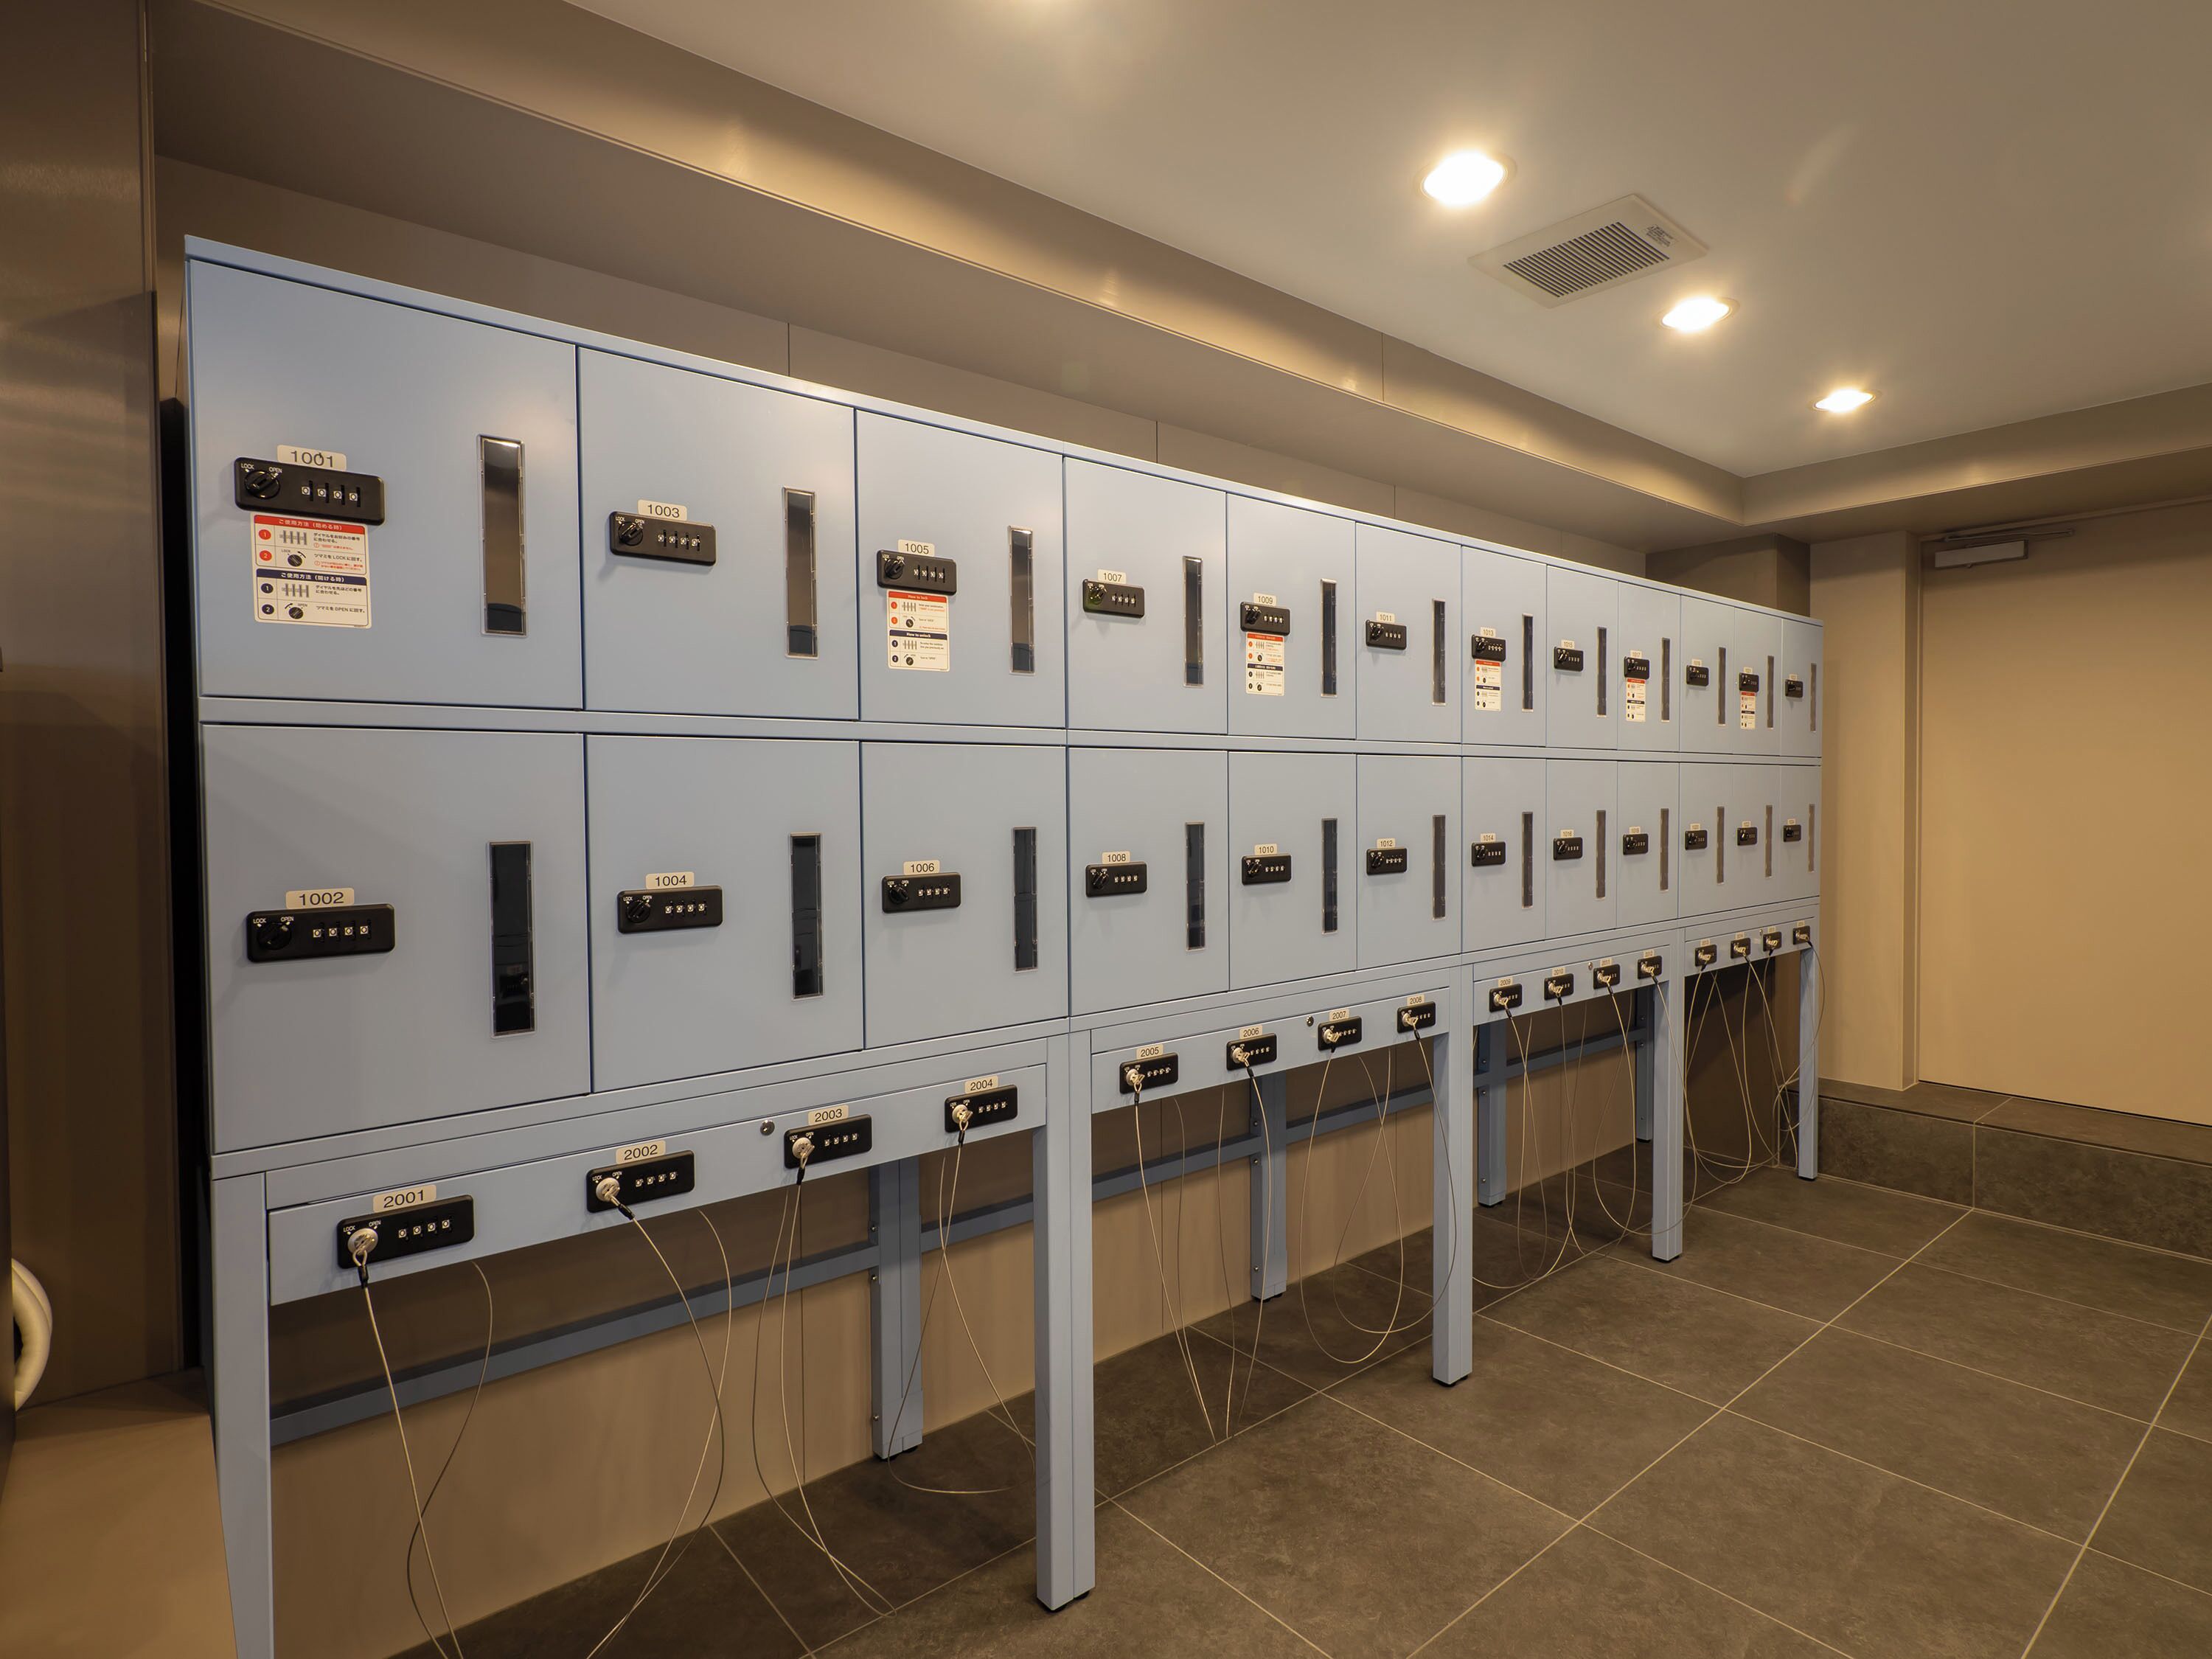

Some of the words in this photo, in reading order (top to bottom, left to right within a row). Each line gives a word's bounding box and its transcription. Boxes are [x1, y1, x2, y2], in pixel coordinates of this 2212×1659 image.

[291, 451, 335, 467] 1001
[648, 504, 680, 518] 1003
[905, 543, 929, 554] 1005
[1103, 573, 1122, 582] 1007
[1258, 596, 1273, 605] 1009
[1259, 846, 1274, 854] 1010
[1107, 854, 1127, 862] 1008
[911, 863, 935, 873] 1006
[655, 874, 687, 886] 1004
[299, 891, 344, 906] 1002
[1500, 978, 1511, 987] 2009
[1409, 996, 1422, 1004] 2008
[1332, 1011, 1346, 1020] 2007
[1243, 1027, 1259, 1037] 2006
[1141, 1047, 1159, 1057] 2005
[970, 1079, 993, 1091] 2004
[815, 1108, 842, 1122] 2003
[624, 1144, 658, 1161] 2002
[383, 1189, 424, 1208] 2001
